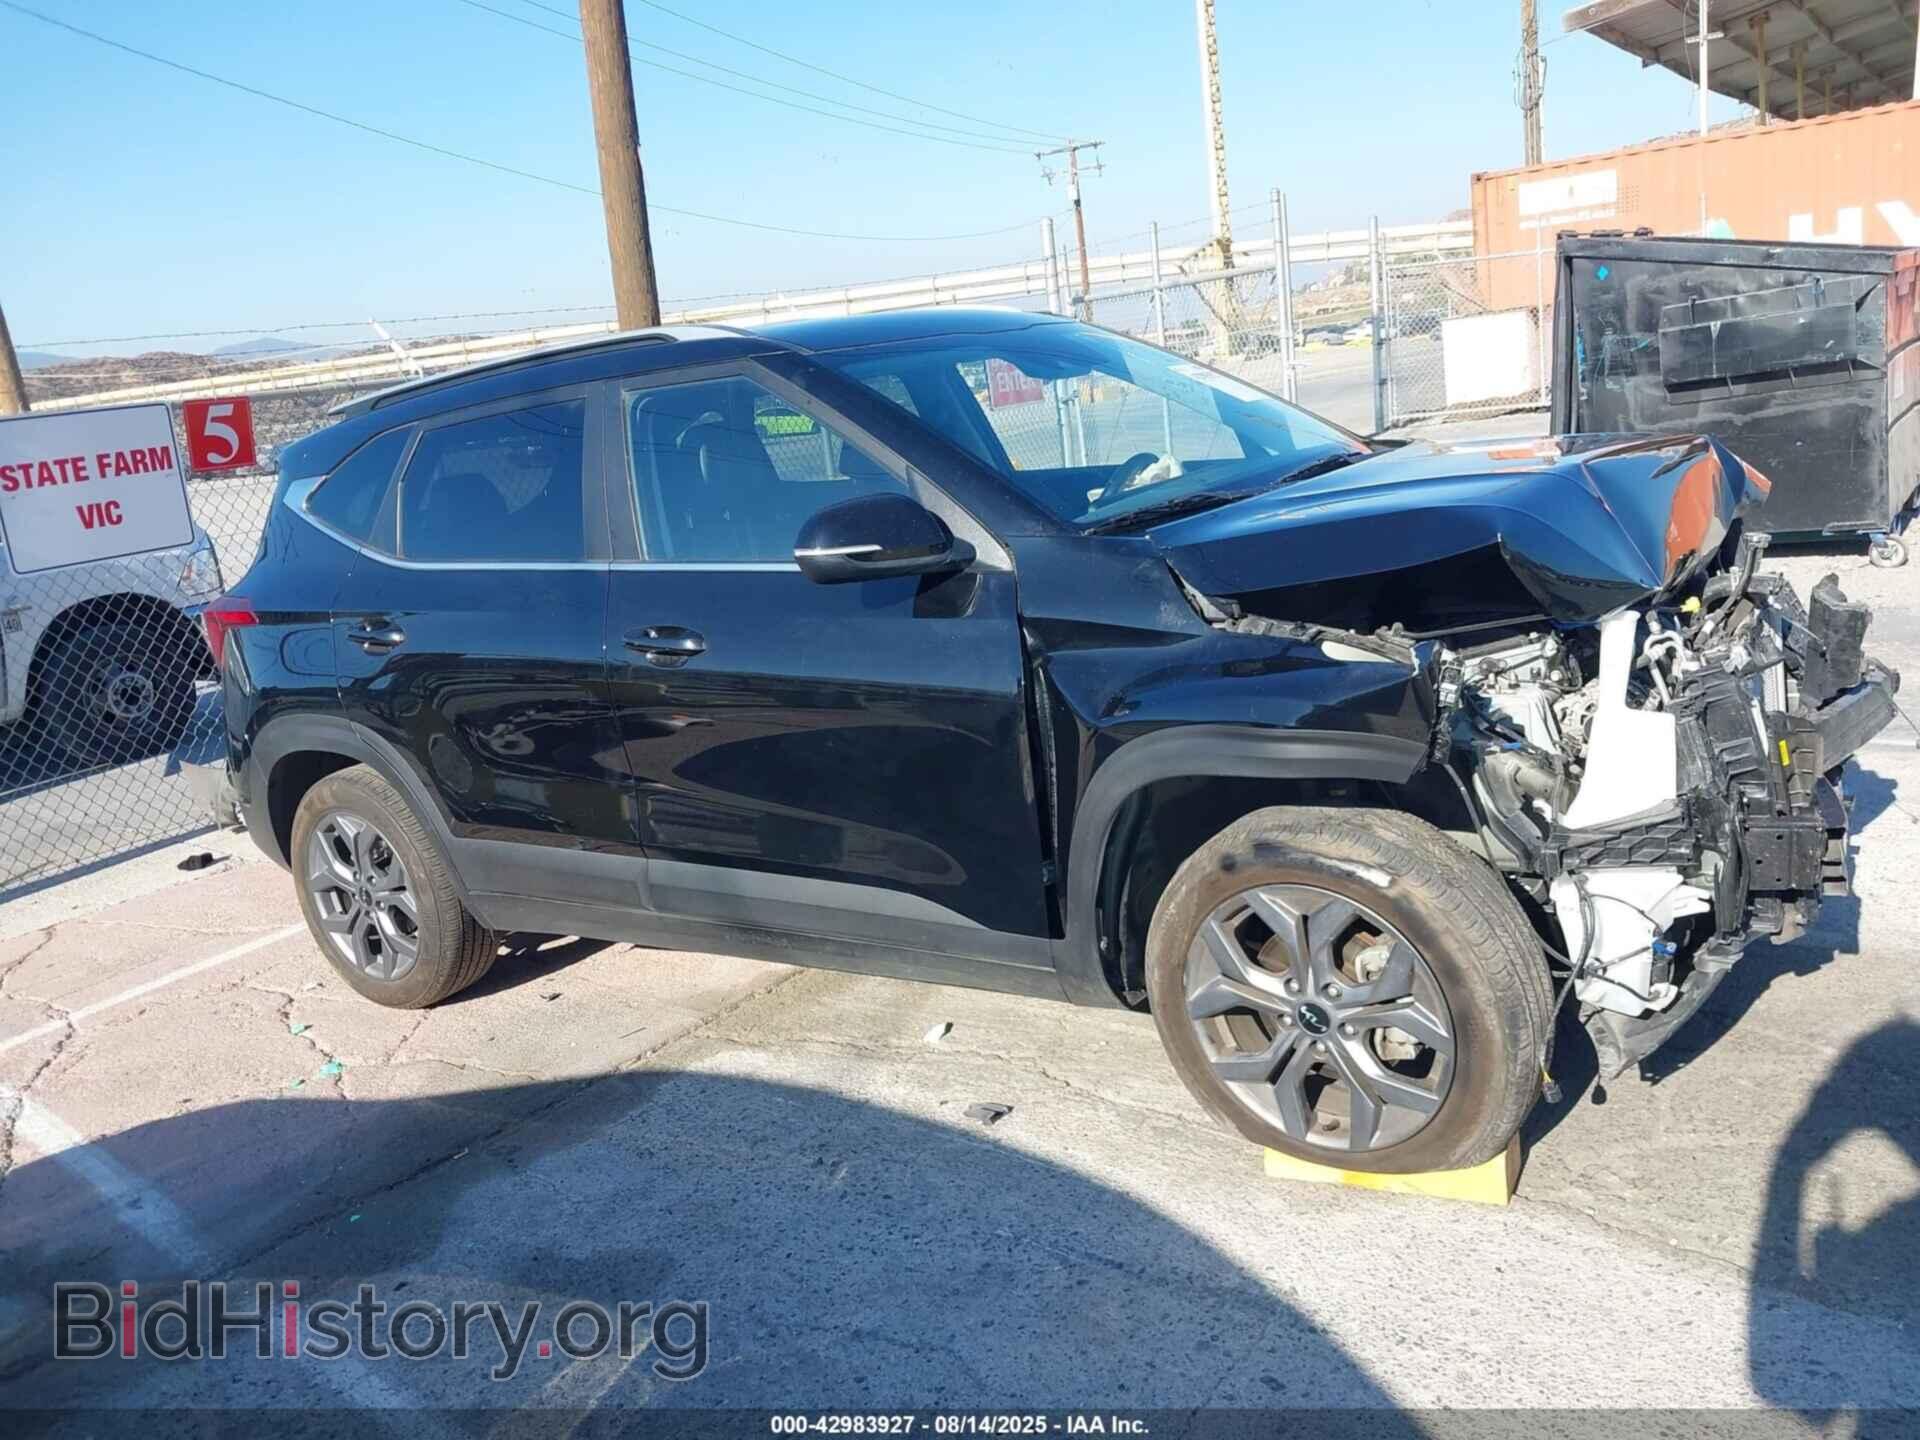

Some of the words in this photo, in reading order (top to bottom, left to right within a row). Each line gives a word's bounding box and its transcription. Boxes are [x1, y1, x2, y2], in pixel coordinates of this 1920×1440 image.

[204, 403, 240, 464] 5
[0, 456, 89, 492] STATE
[96, 445, 174, 479] FARM
[76, 500, 122, 529] VIC
